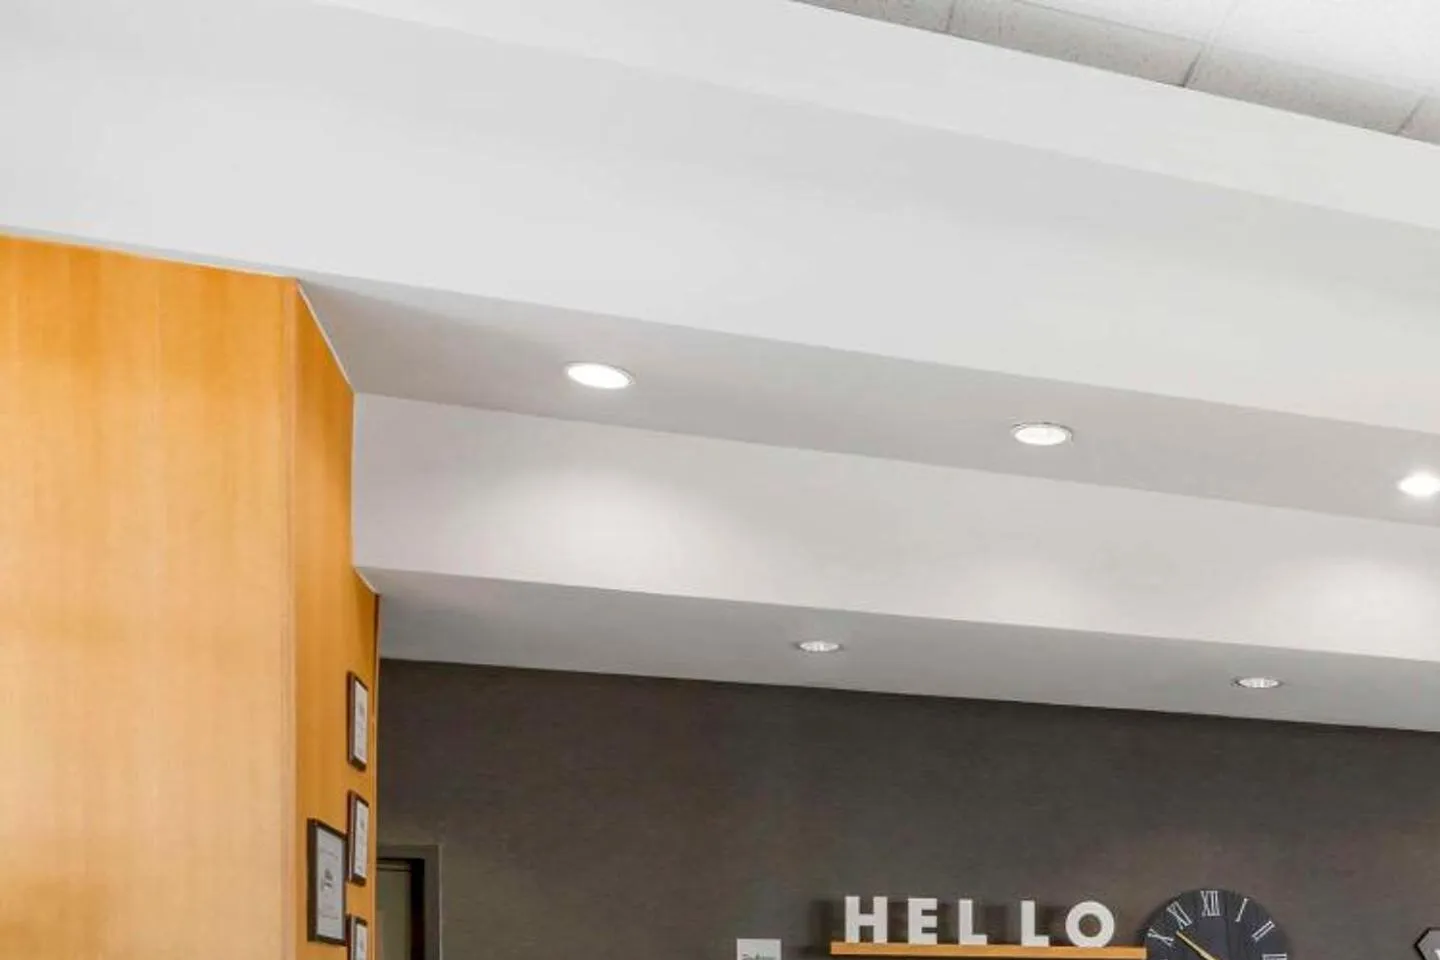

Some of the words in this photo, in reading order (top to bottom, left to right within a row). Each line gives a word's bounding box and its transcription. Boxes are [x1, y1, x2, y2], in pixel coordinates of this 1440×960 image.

[1200, 890, 1221, 917] XII
[844, 896, 1115, 948] HELLO
[1147, 927, 1175, 948] X
